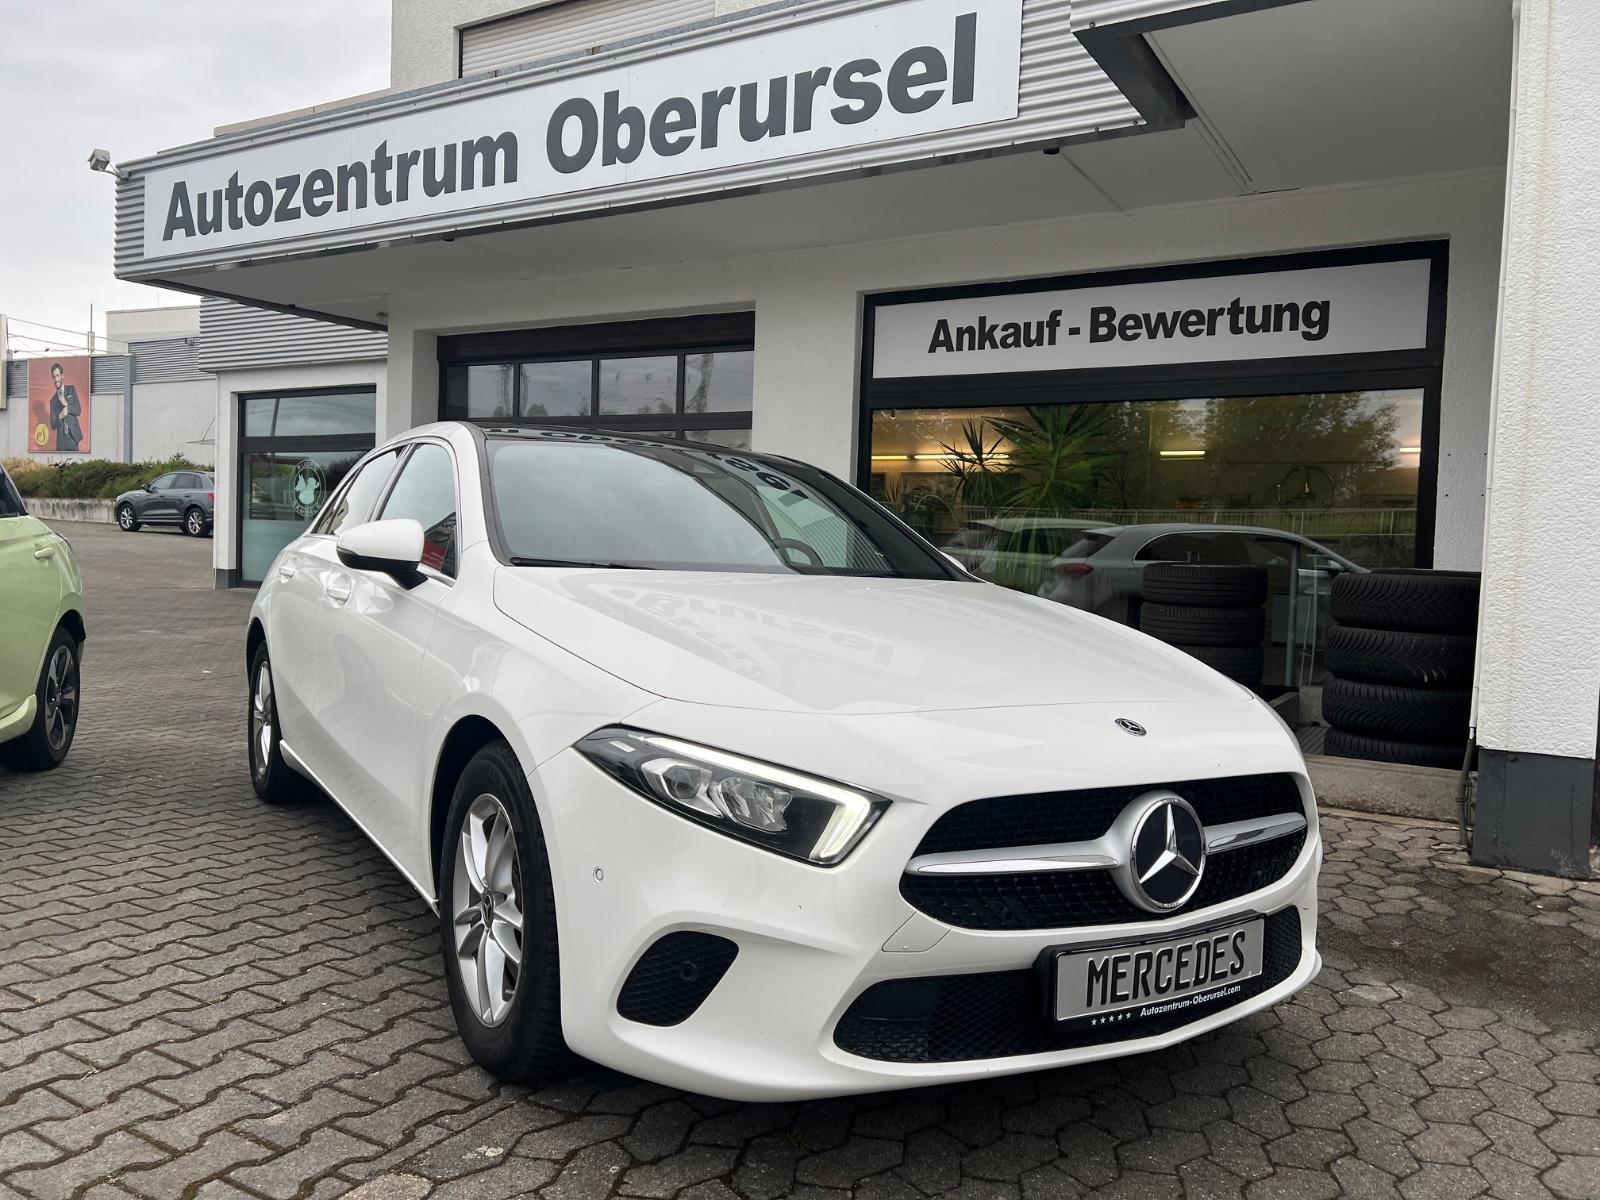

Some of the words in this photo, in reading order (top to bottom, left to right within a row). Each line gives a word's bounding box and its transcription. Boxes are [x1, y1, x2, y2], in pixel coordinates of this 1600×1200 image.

[163, 132, 518, 241] Autozentrum
[547, 12, 977, 174] Oberursel
[928, 310, 1063, 354] Ankauf
[1089, 297, 1331, 344] Bewertung
[1086, 930, 1246, 1008] MERCEDES
[1139, 984, 1242, 1018] Autozentrum-Oberursel.com
